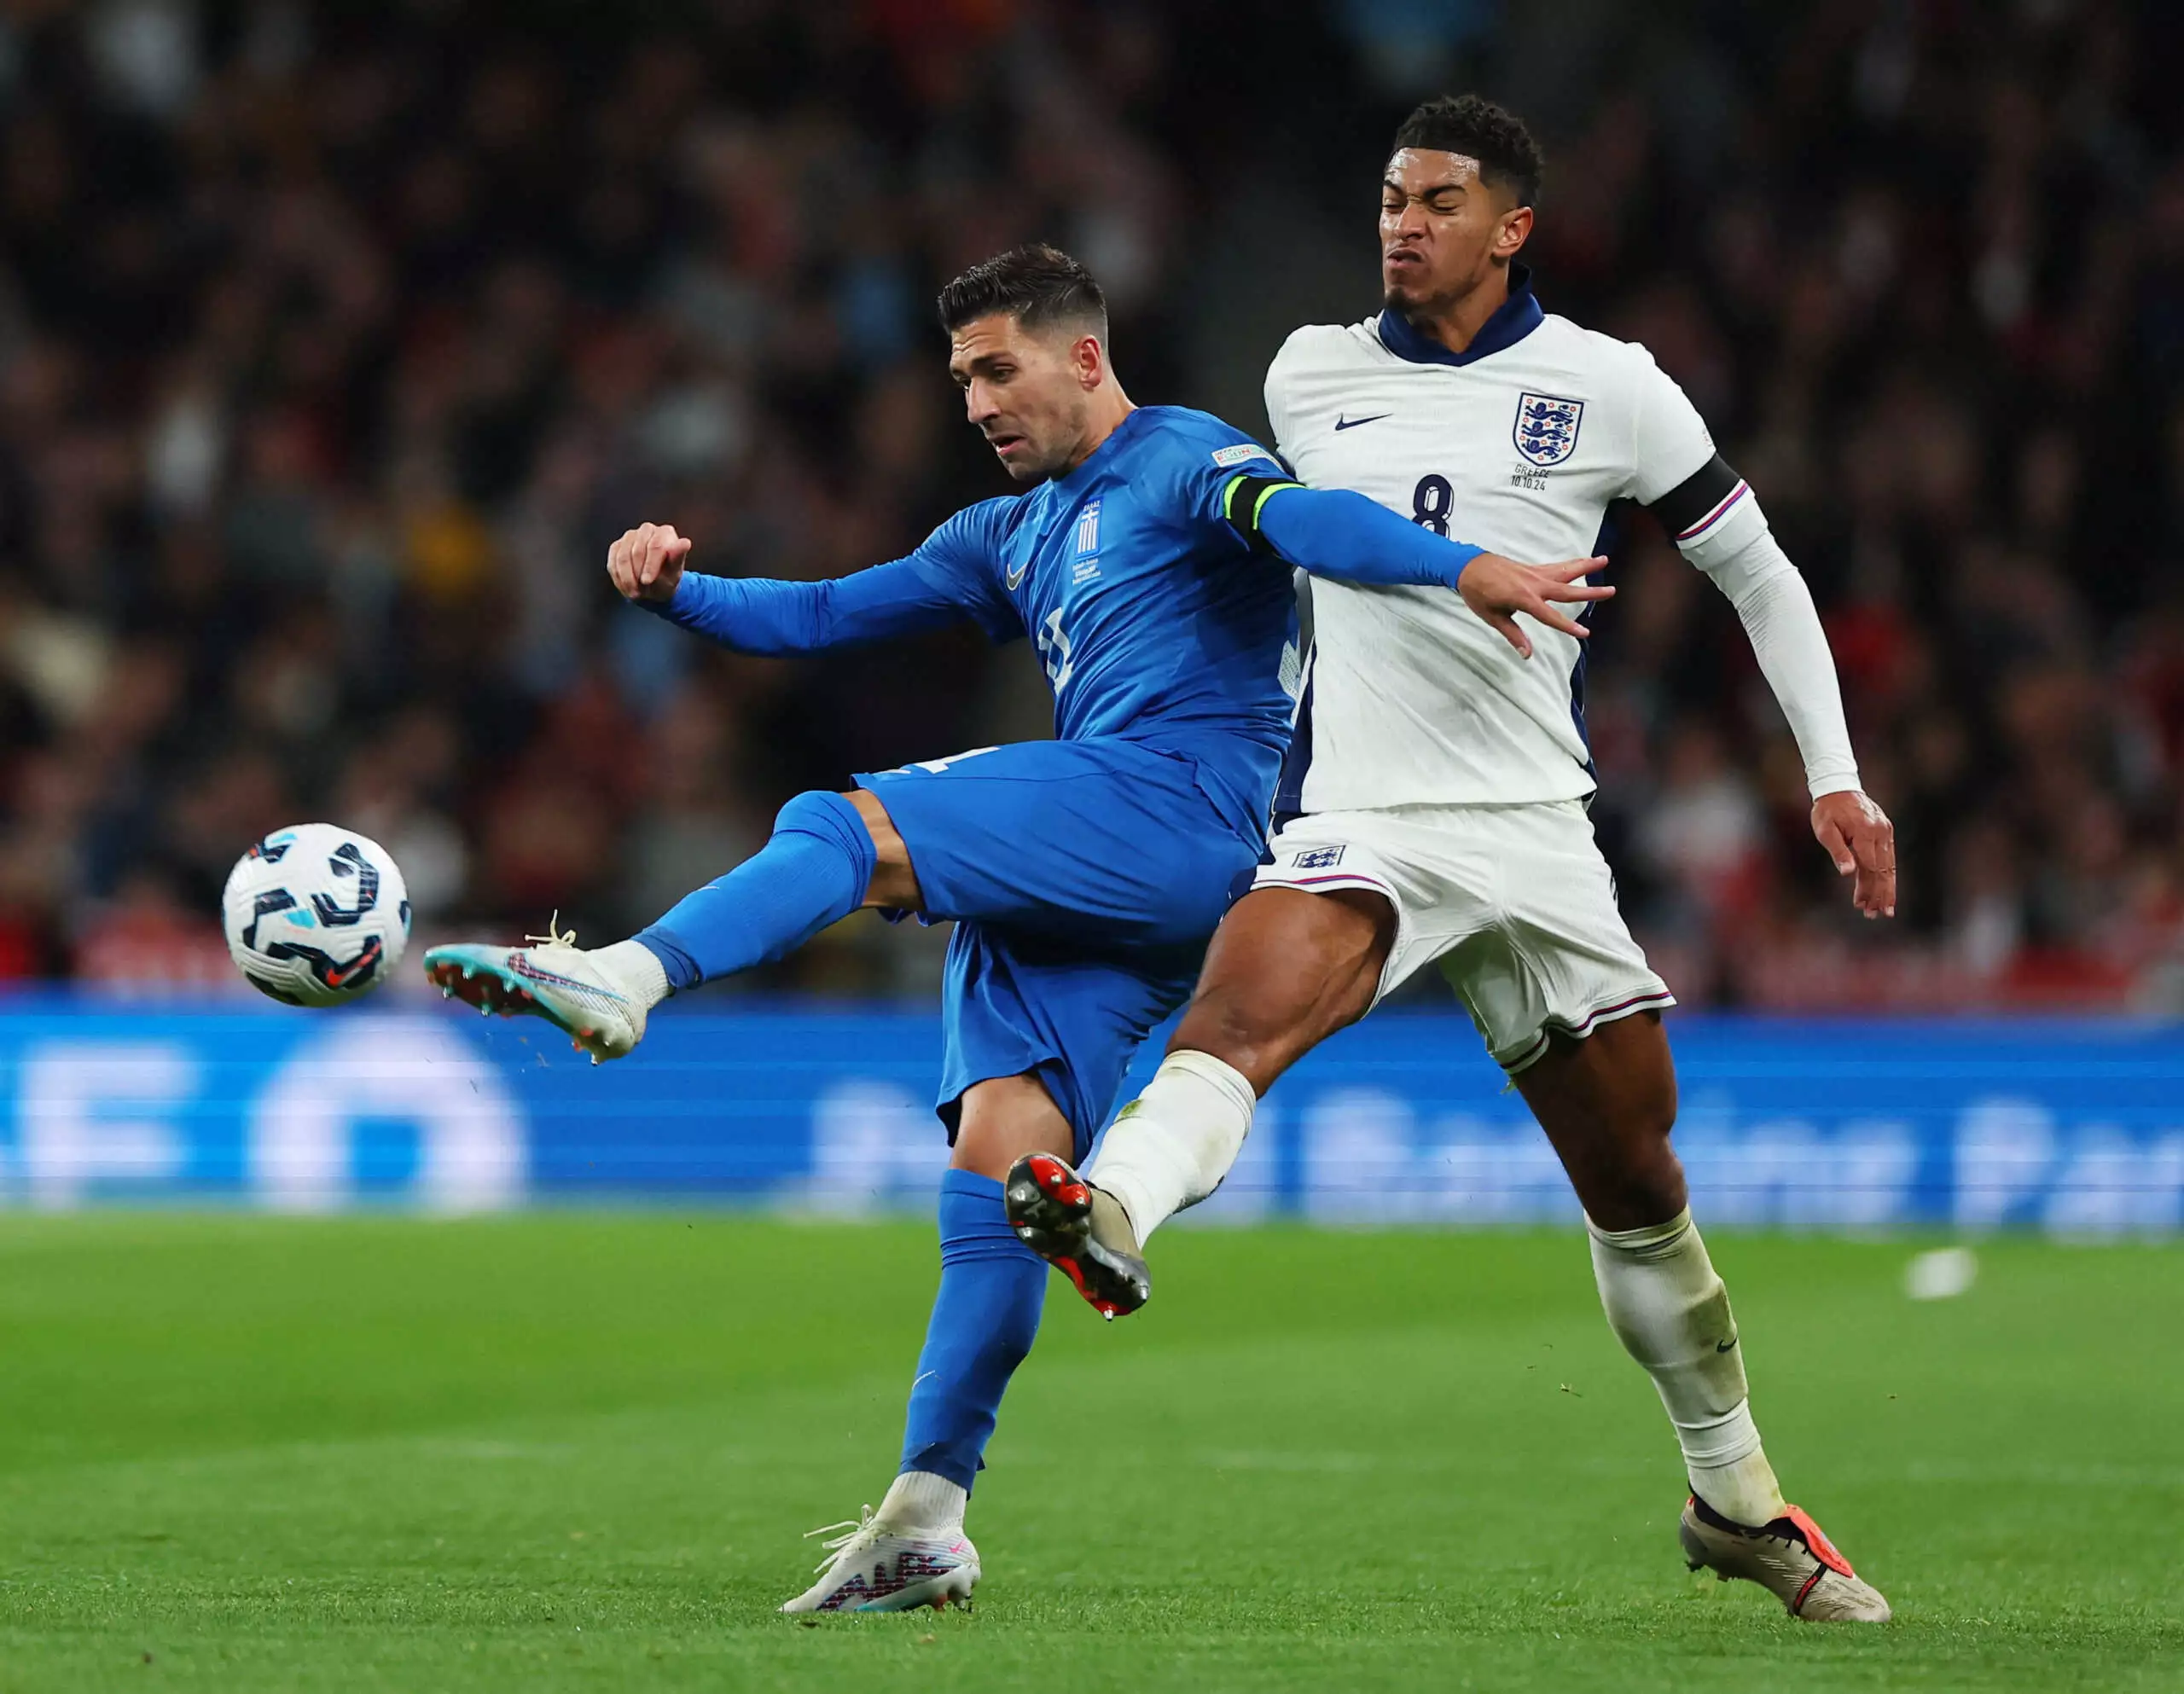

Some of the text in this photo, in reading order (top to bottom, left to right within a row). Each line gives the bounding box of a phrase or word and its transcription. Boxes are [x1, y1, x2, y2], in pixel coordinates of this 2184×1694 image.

[1514, 463, 1552, 479] GREECE
[1511, 474, 1546, 491] 10.10.24
[1412, 474, 1454, 539] 8
